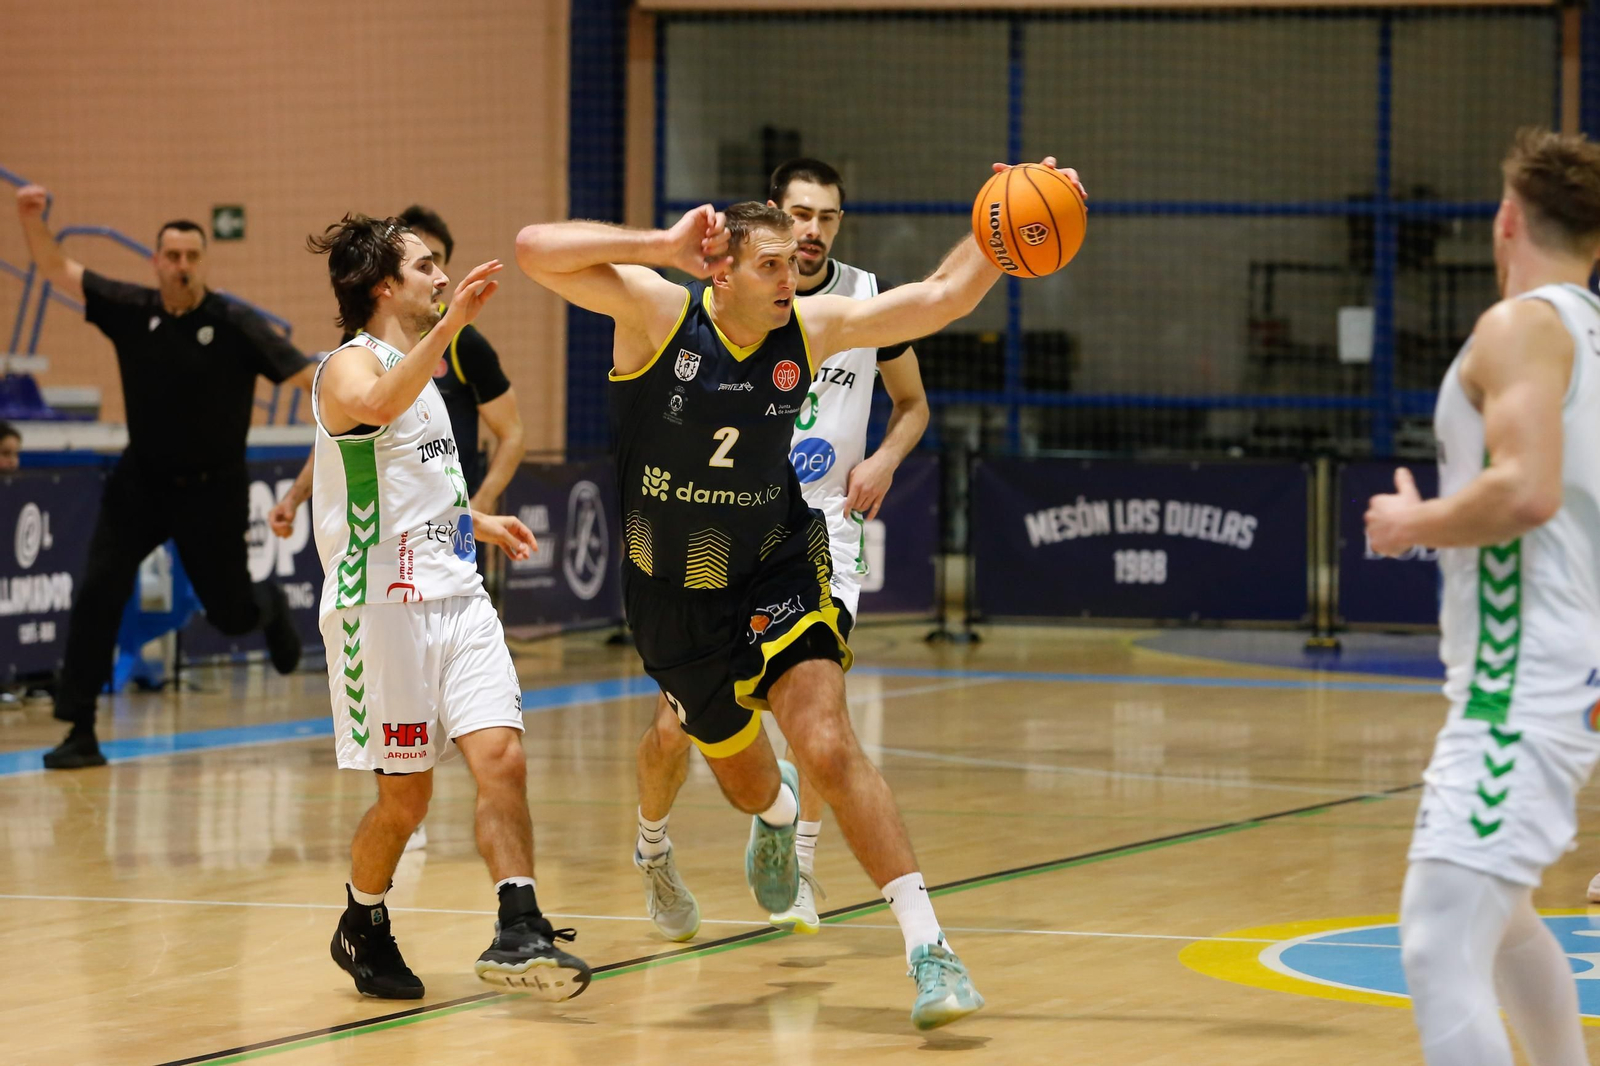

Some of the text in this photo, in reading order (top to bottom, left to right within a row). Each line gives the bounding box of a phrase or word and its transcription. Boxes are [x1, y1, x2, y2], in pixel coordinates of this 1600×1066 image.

[989, 202, 1019, 272] Wilson
[709, 427, 740, 467] 2
[675, 481, 781, 507] damex.io
[1024, 495, 1258, 550] MESÓN LAS DUELAS
[406, 549, 414, 581] etxano
